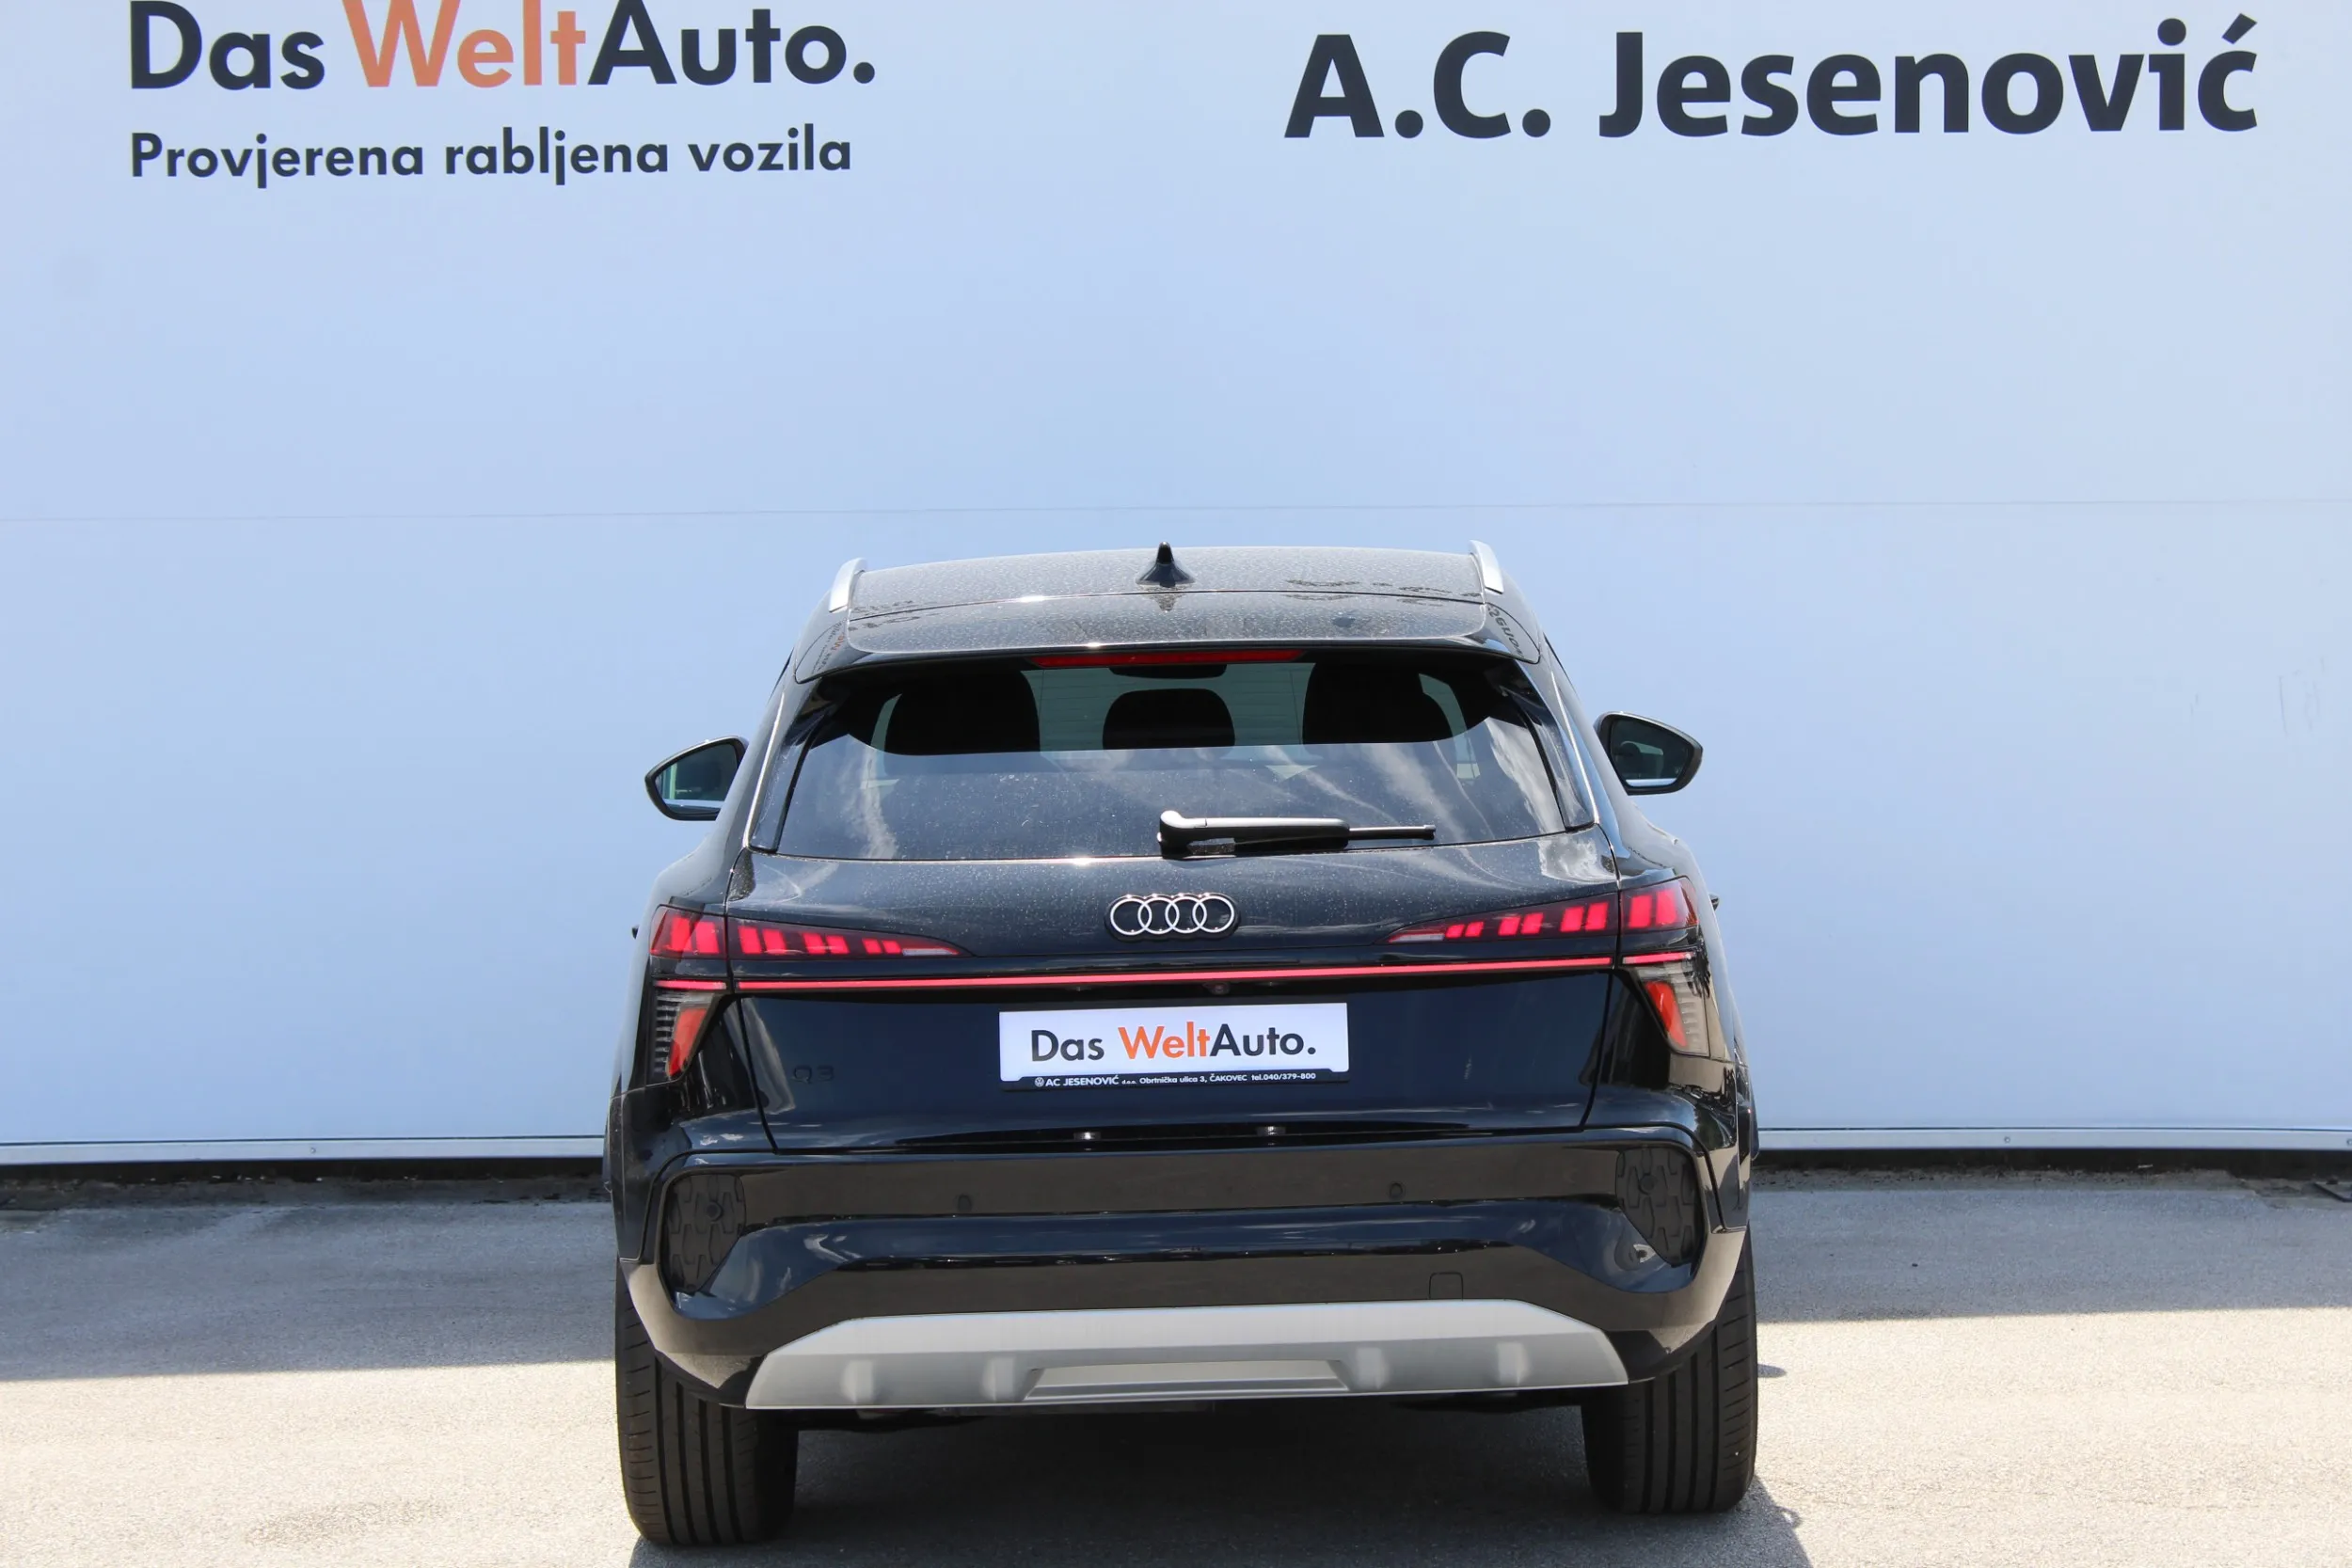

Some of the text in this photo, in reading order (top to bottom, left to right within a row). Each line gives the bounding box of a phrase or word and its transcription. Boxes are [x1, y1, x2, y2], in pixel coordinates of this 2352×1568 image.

[131, 0, 875, 90] Das WeltAuto.
[1285, 14, 2258, 139] A.C. Jesenović
[132, 122, 850, 189] Provjerena rabljena vozila
[1031, 1022, 1316, 1062] Das WeltAuto.
[793, 1065, 834, 1085] Q3
[1045, 1078, 1060, 1086] AC
[1063, 1074, 1119, 1086] JESENOVIĆ
[1139, 1076, 1177, 1085] Obrtnička
[1210, 1073, 1248, 1082] ČAKOVEC
[1251, 1072, 1316, 1081] tel.040/379-800
